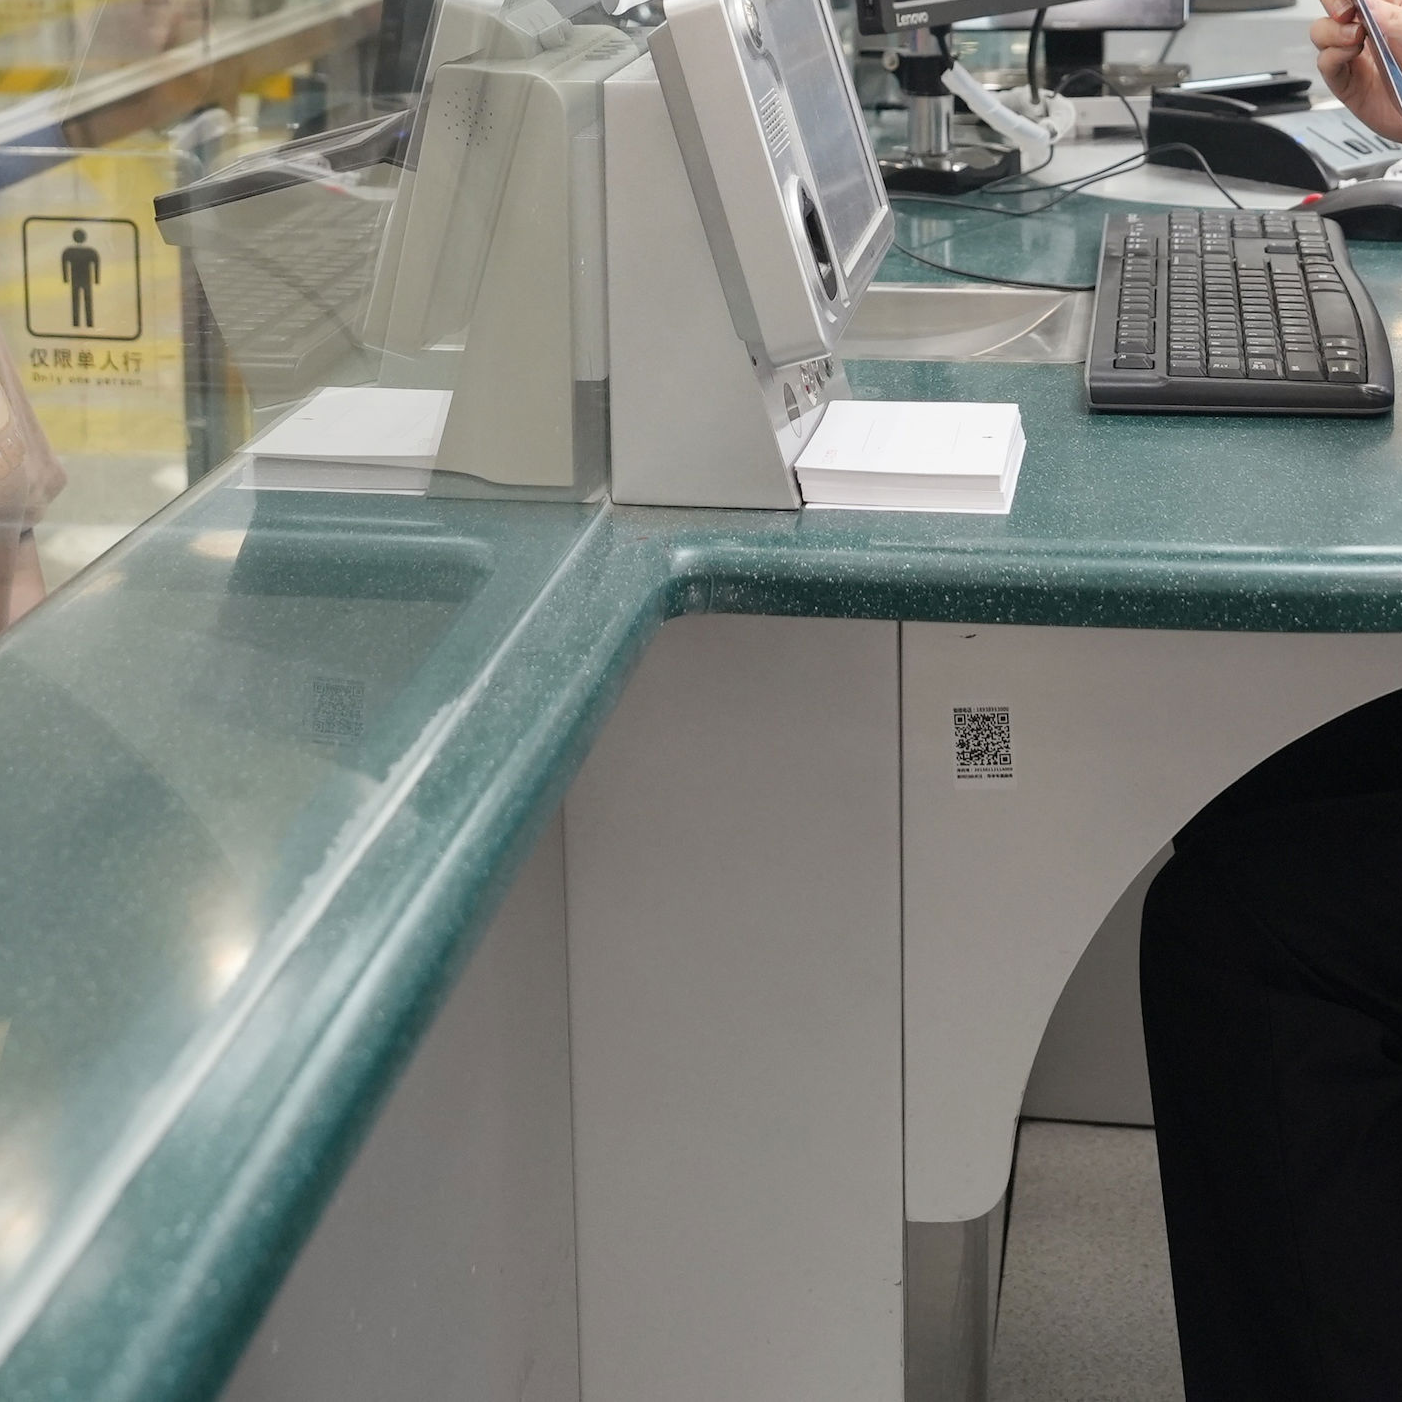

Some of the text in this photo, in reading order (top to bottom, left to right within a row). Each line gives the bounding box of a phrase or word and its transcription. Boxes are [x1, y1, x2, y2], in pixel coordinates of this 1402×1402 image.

[895, 11, 929, 27] Lenovo
[30, 348, 143, 373] 仅限单人行
